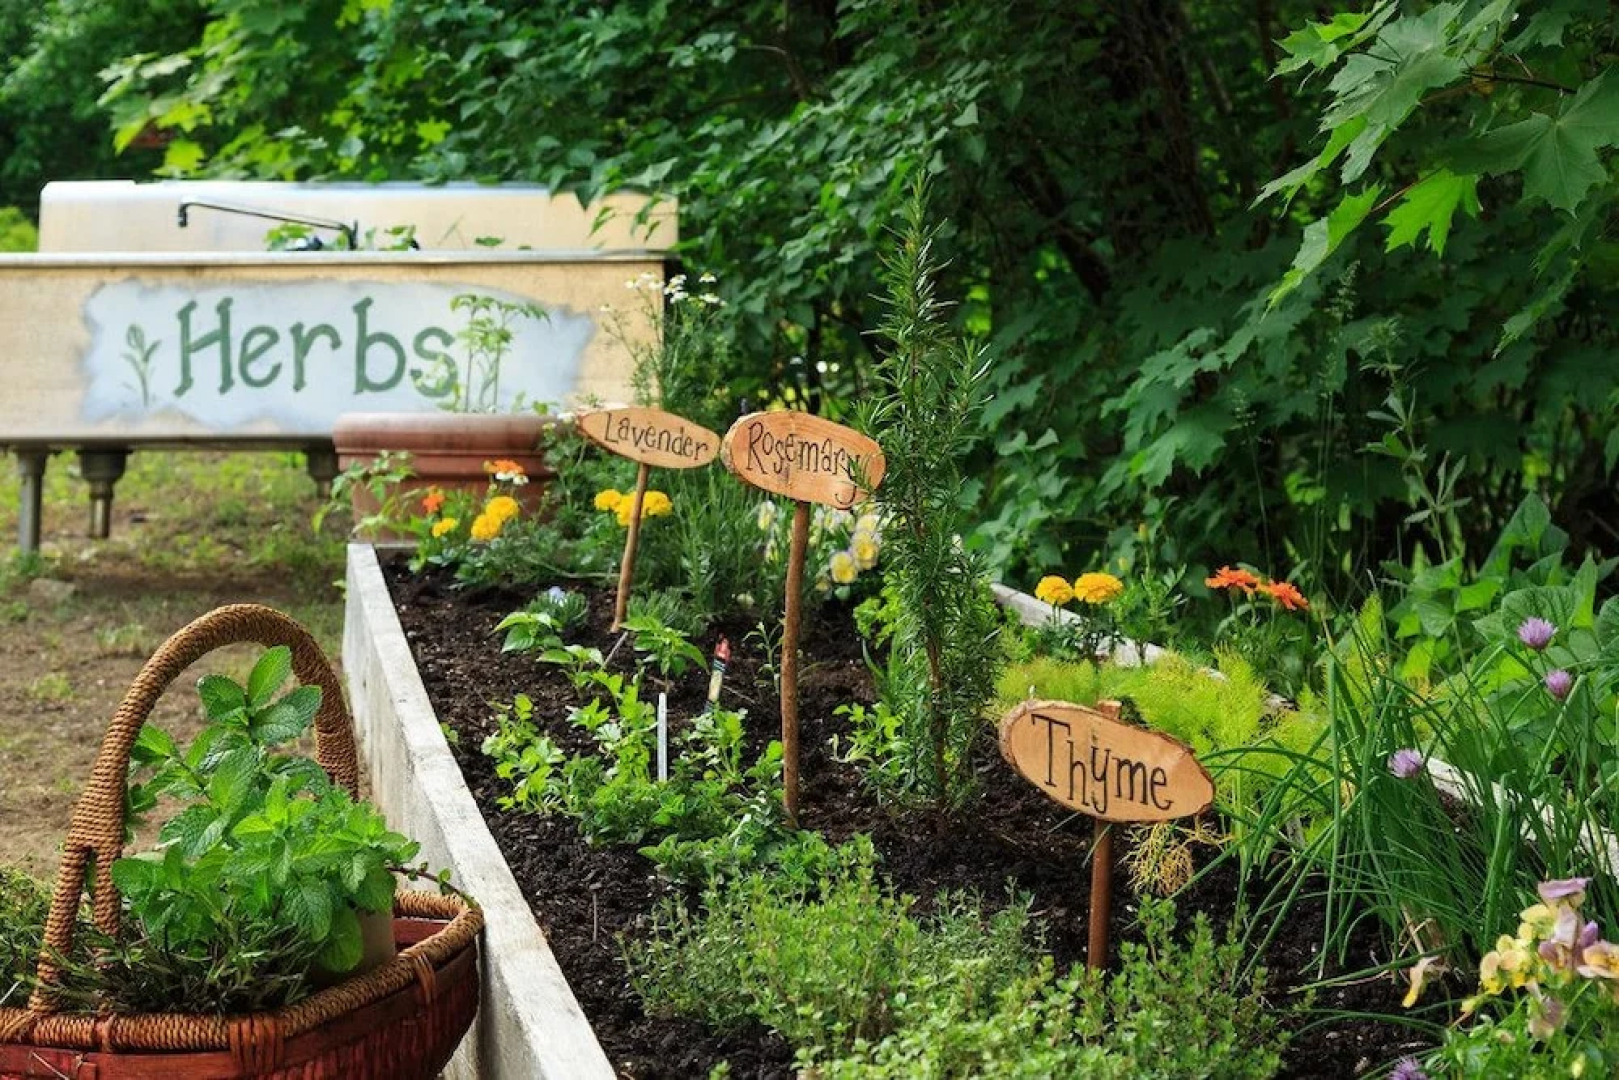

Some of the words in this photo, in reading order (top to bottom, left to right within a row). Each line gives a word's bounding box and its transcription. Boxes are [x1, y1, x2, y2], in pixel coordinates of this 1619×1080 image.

[174, 297, 460, 398] Herbs
[603, 412, 708, 461] Lavender
[745, 421, 861, 505] Rosemary
[1031, 713, 1174, 814] Thyme
